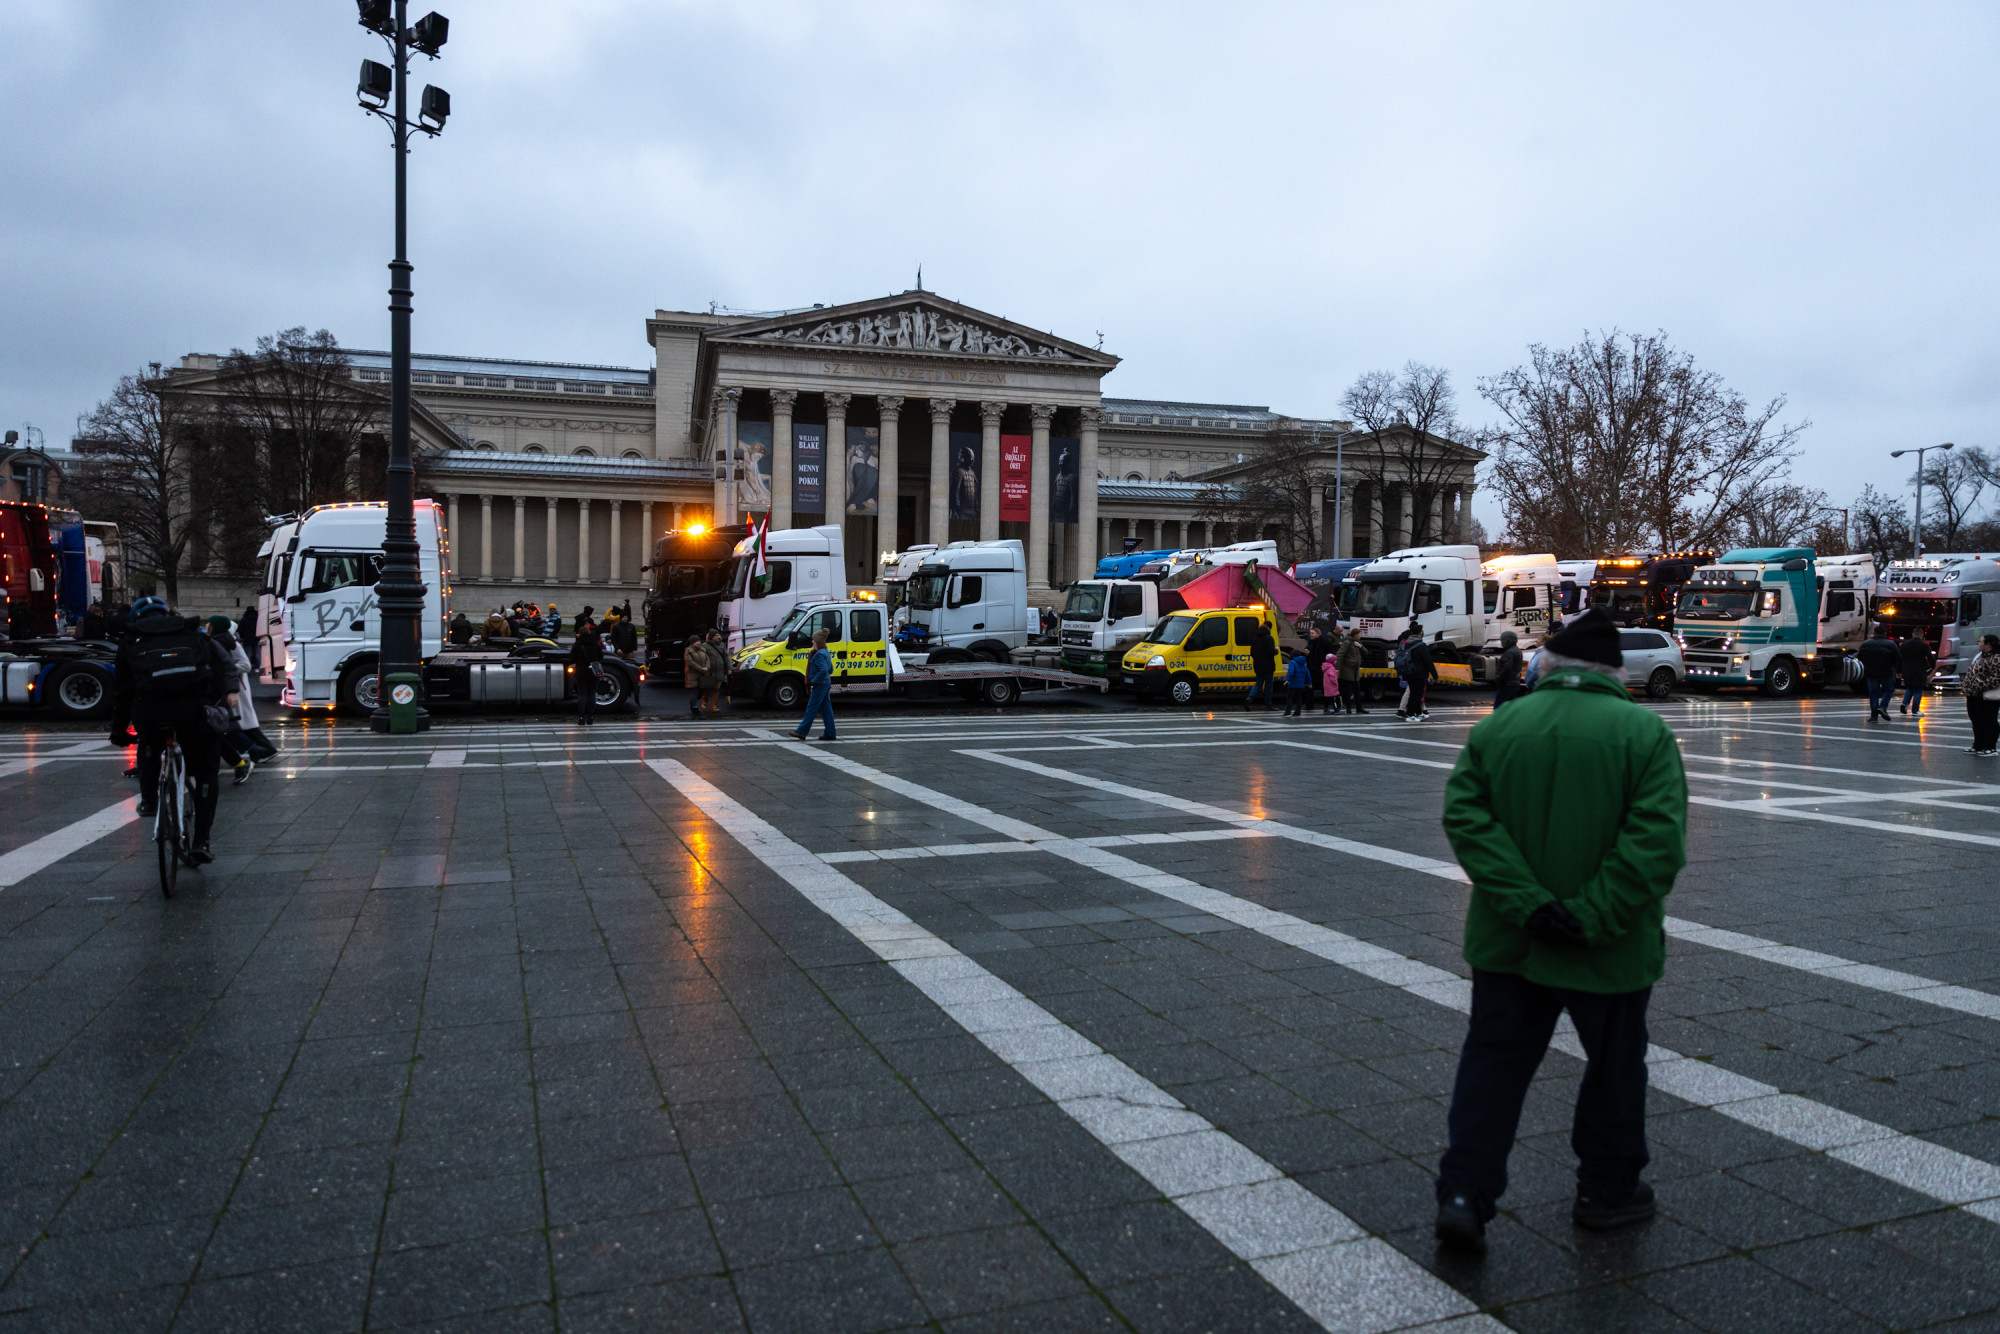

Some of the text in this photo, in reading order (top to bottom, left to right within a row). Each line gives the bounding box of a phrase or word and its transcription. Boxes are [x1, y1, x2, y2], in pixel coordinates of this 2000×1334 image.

[798, 441, 820, 450] BLAKE
[798, 464, 820, 473] MENNY
[798, 477, 820, 486] POKOL
[850, 650, 873, 659] 0-24
[1232, 654, 1252, 662] KCT
[864, 660, 885, 668] 5073
[1169, 660, 1186, 669] 0-24
[1197, 662, 1253, 672] AUTÓMENTÉS
